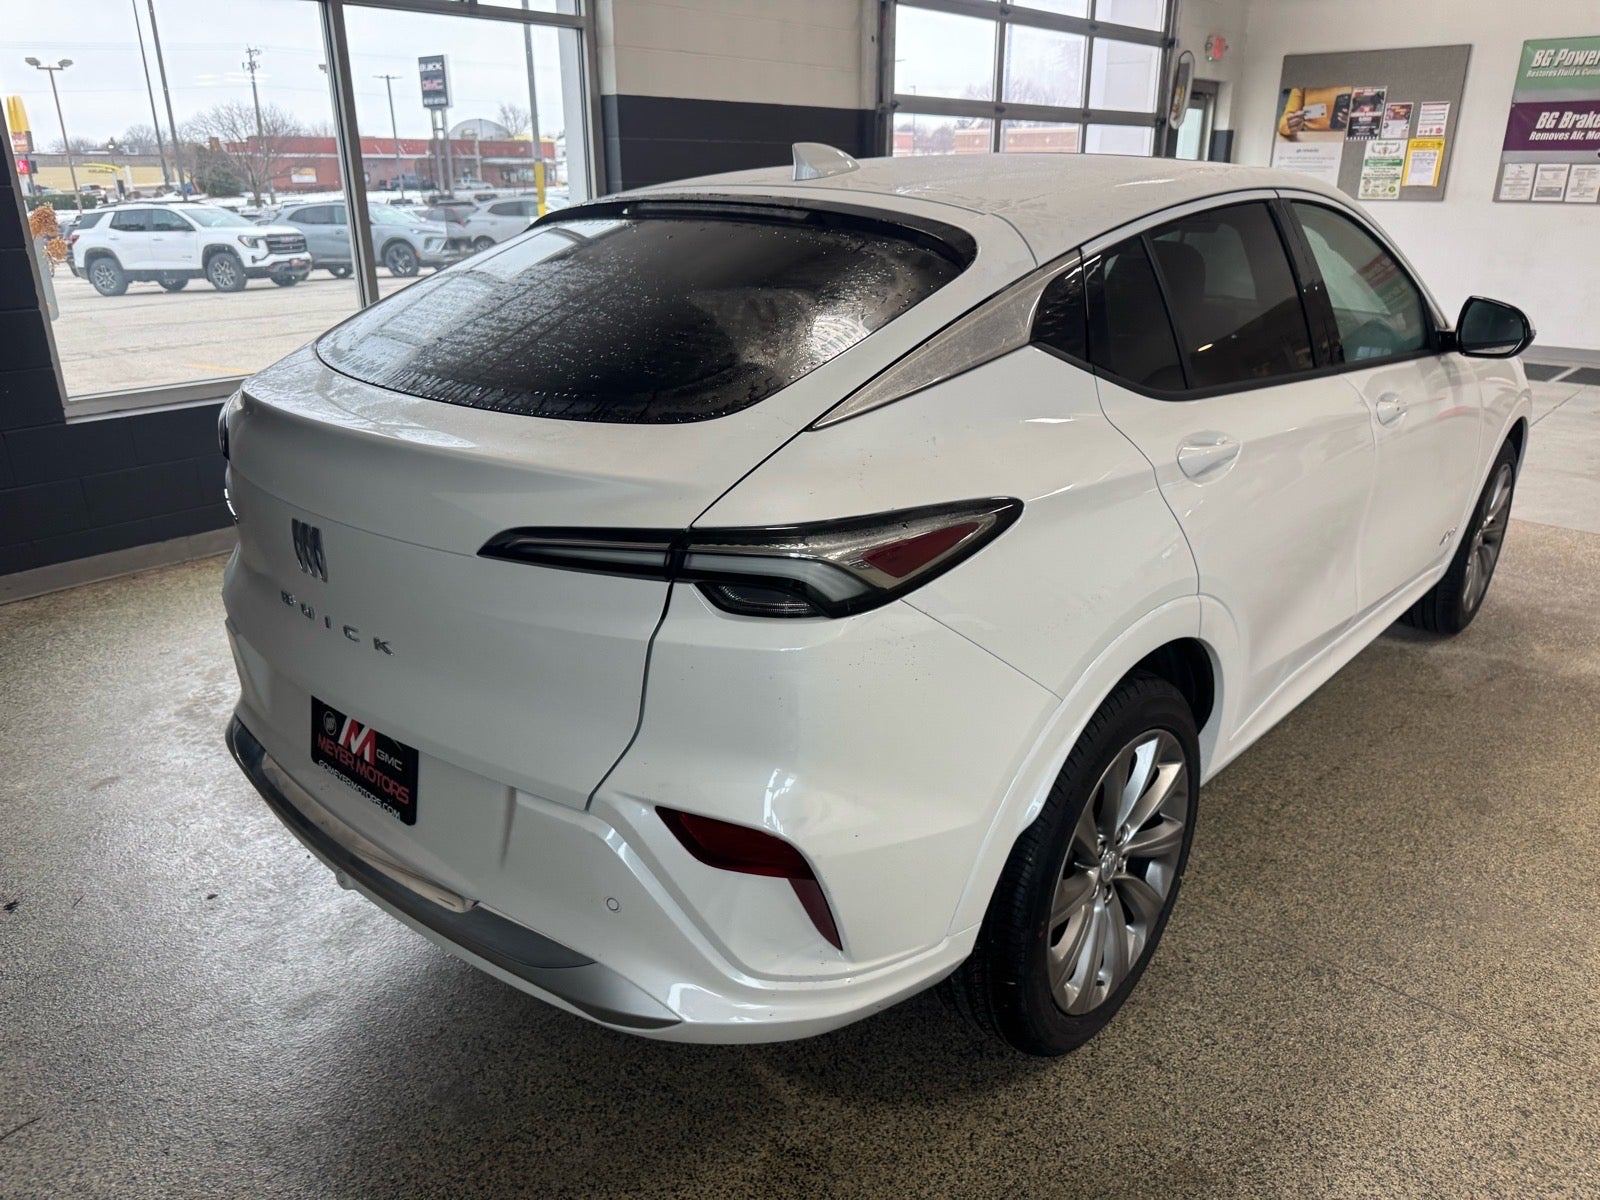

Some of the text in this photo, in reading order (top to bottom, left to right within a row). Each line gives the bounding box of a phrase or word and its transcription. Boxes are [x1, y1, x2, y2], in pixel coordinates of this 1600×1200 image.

[1530, 48, 1600, 67] BG Power
[1535, 110, 1600, 129] BG Brake
[1528, 131, 1570, 141] Removes
[1569, 130, 1585, 140] Air,
[281, 590, 394, 656] BUICK
[317, 733, 410, 804] MEYER MOTORS
[376, 748, 403, 771] GMC
[318, 759, 401, 819] GOMEYERMOTORS.COM
